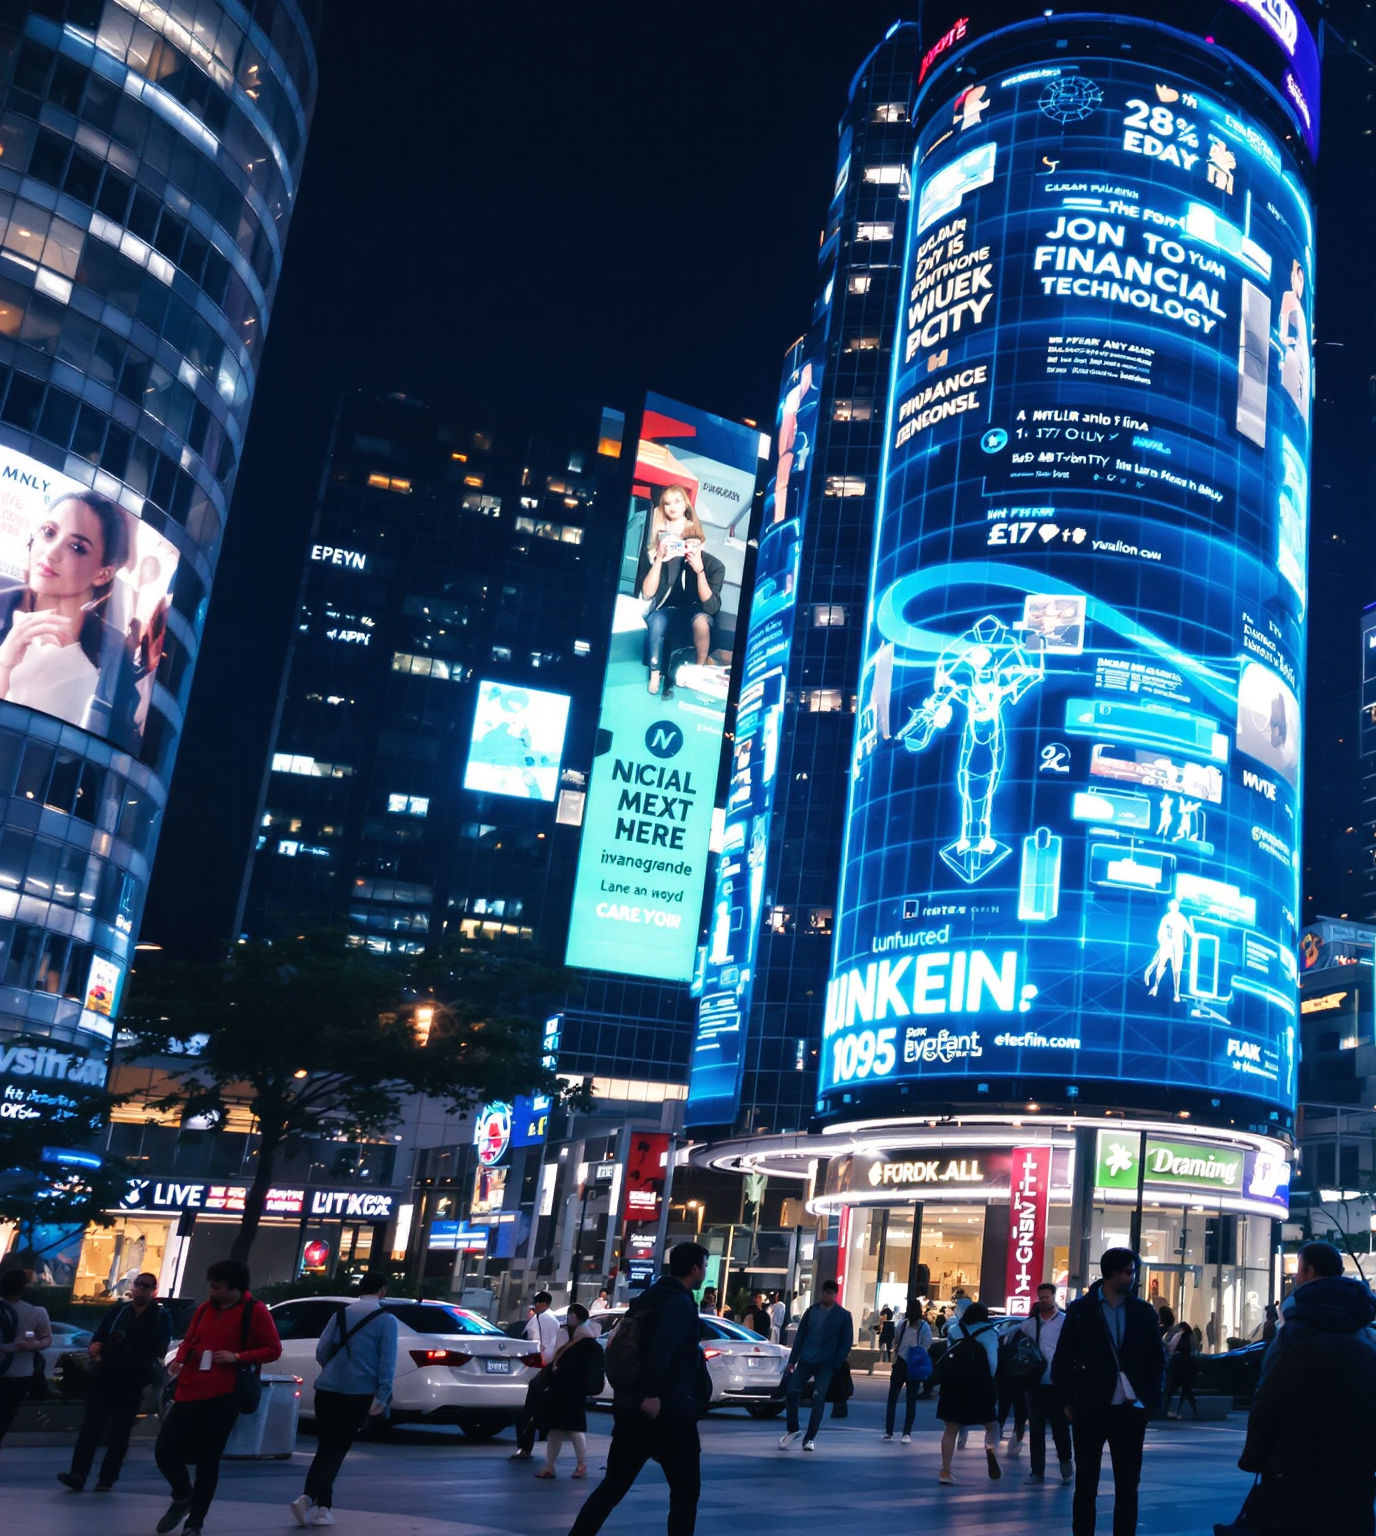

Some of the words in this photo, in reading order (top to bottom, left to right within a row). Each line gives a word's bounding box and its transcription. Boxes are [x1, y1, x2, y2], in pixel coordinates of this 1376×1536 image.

[1045, 216, 1126, 247] JON
[1142, 232, 1185, 263] TO
[1033, 246, 1227, 319] FINANCIAL
[1040, 277, 1216, 334] TECHNOLOGY
[311, 545, 366, 569] EPEYN
[600, 879, 631, 895] Lane
[153, 1183, 204, 1207] LIVE
